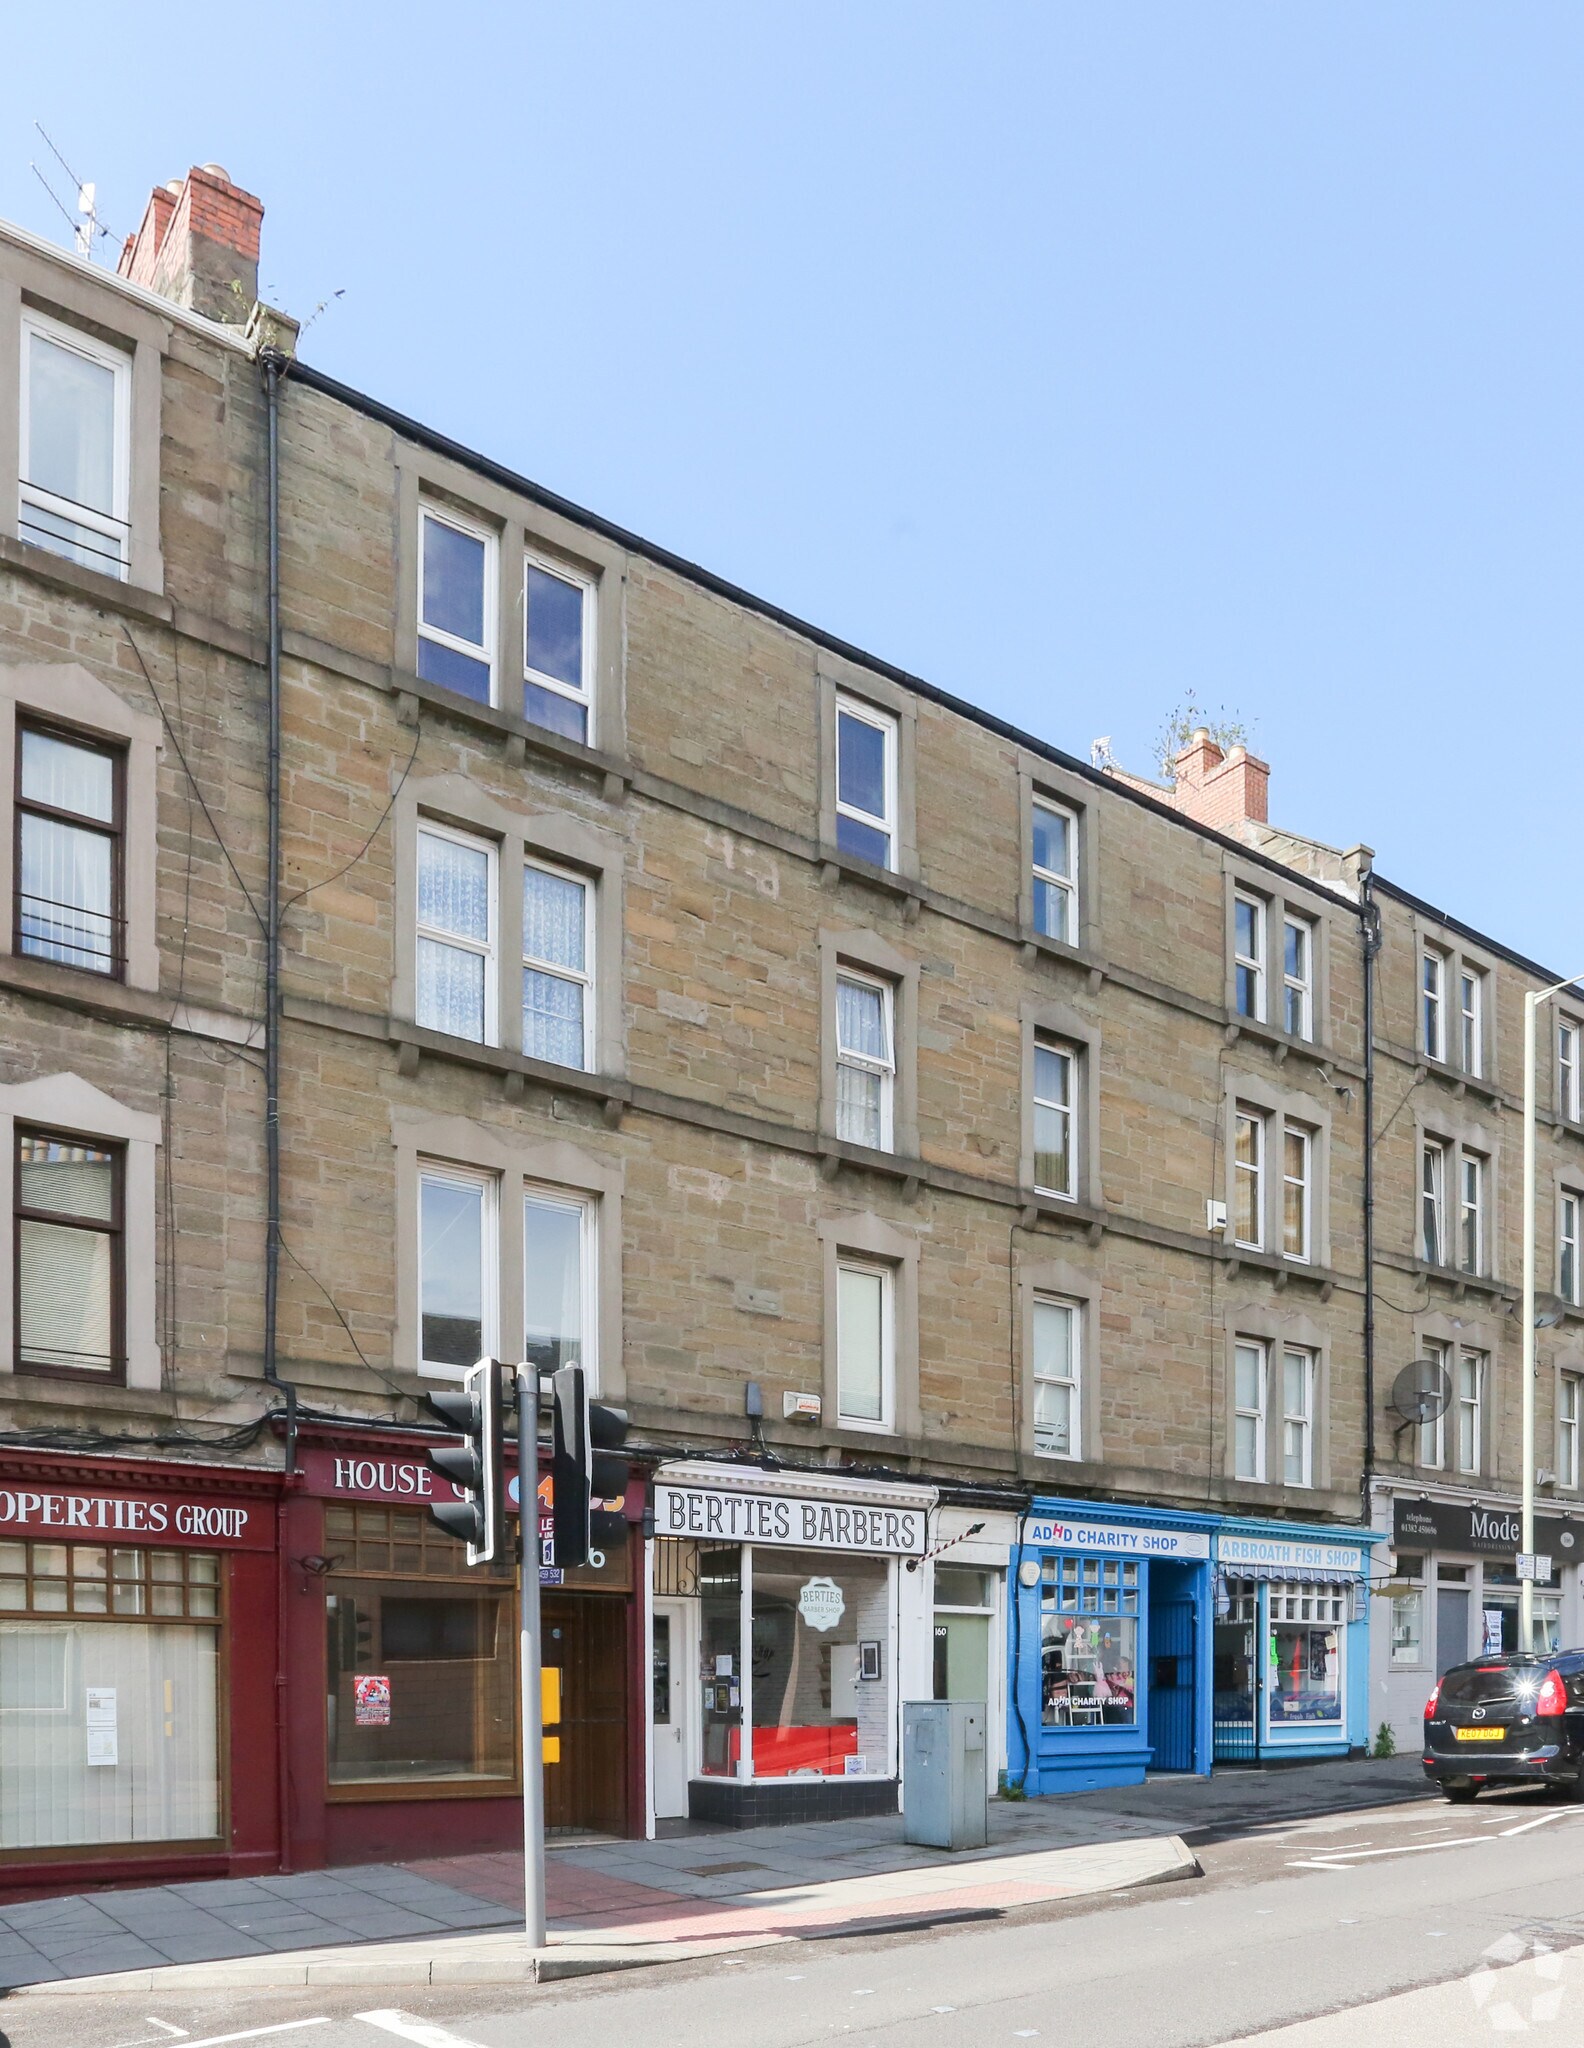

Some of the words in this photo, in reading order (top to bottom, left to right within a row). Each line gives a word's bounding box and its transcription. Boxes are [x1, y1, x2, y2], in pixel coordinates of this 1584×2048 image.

[334, 1458, 433, 1496] HOUSE
[0, 1491, 168, 1532] OPERTIES
[175, 1505, 248, 1538] GROUP
[668, 1492, 790, 1538] BERTIES
[801, 1505, 915, 1549] BARBERS
[1470, 1511, 1520, 1542] Mode
[1032, 1523, 1073, 1542] ADHD
[1077, 1530, 1138, 1548] CHARITY
[1143, 1536, 1178, 1551] SHOP
[1222, 1540, 1291, 1562] ARBROATH
[1295, 1547, 1322, 1565] FISH
[1326, 1549, 1358, 1567] SHOP
[803, 1590, 841, 1604] BERTIES
[935, 1627, 947, 1636] 160
[1072, 1697, 1106, 1706] CHARITY
[1108, 1697, 1129, 1705] SHOP
